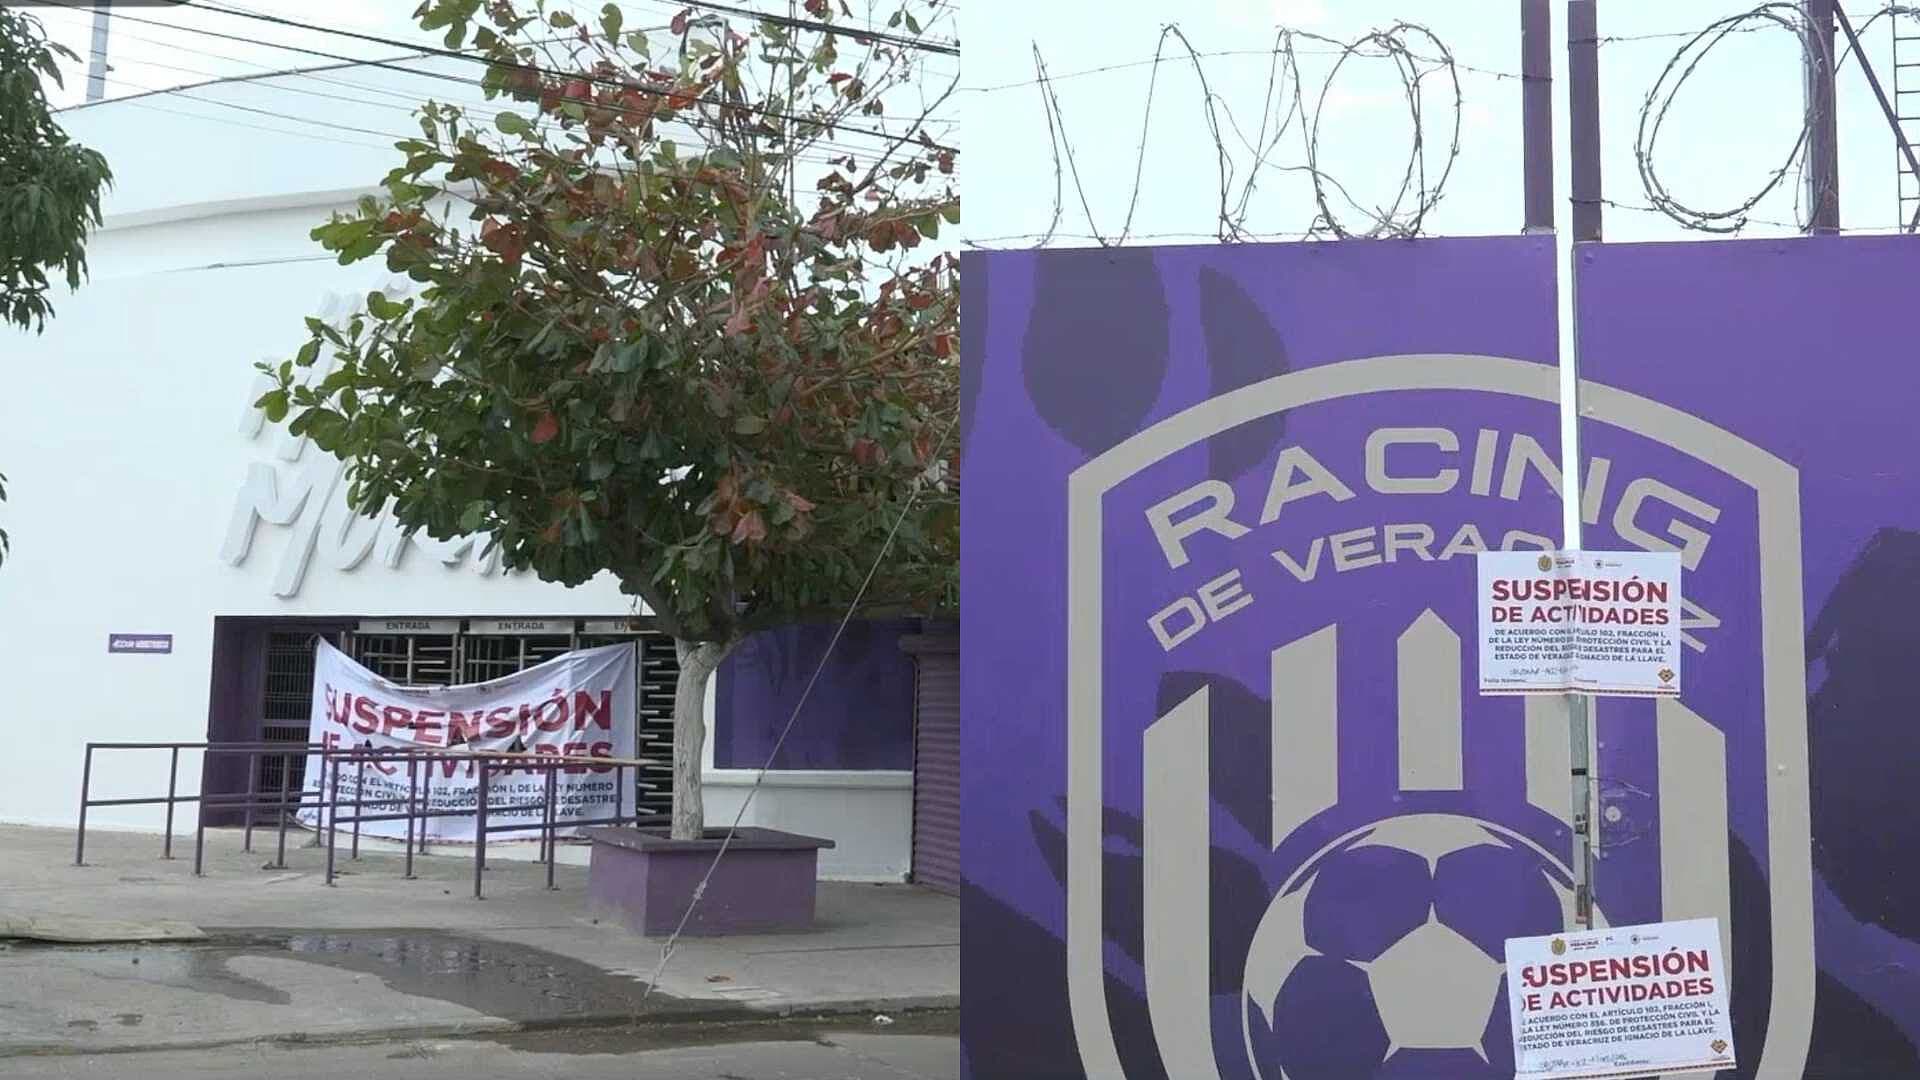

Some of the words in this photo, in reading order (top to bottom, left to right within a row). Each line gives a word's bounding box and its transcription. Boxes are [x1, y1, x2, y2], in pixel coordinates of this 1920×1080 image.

[1145, 427, 1721, 571] RACING
[1147, 569, 1254, 652] DE
[1492, 607, 1522, 623] DE
[386, 622, 431, 630] ENTRADA
[498, 622, 545, 630] ENTRADA
[1550, 977, 1714, 1010] ACTIVIDADES
[1529, 1014, 1568, 1024] ACUERDO
[1570, 1012, 1588, 1020] CON
[1602, 1007, 1643, 1017] ARTÍCULO
[1663, 1001, 1706, 1011] FRACCIÓN
[1609, 1017, 1622, 1025] DE
[1623, 1012, 1676, 1024] PROTECCIÓN
[1678, 1010, 1699, 1018] CIVIL
[1585, 1027, 1615, 1036] RIESGO
[1617, 1026, 1629, 1034] DE
[1630, 1022, 1678, 1032] DESASTRES
[1680, 1020, 1703, 1028] PARA
[1552, 1040, 1564, 1048] DE
[1565, 1037, 1610, 1047] VERACRUZ
[1611, 1034, 1624, 1042] DE
[1625, 1032, 1659, 1041] IGNACIO
[1661, 1030, 1673, 1038] DE
